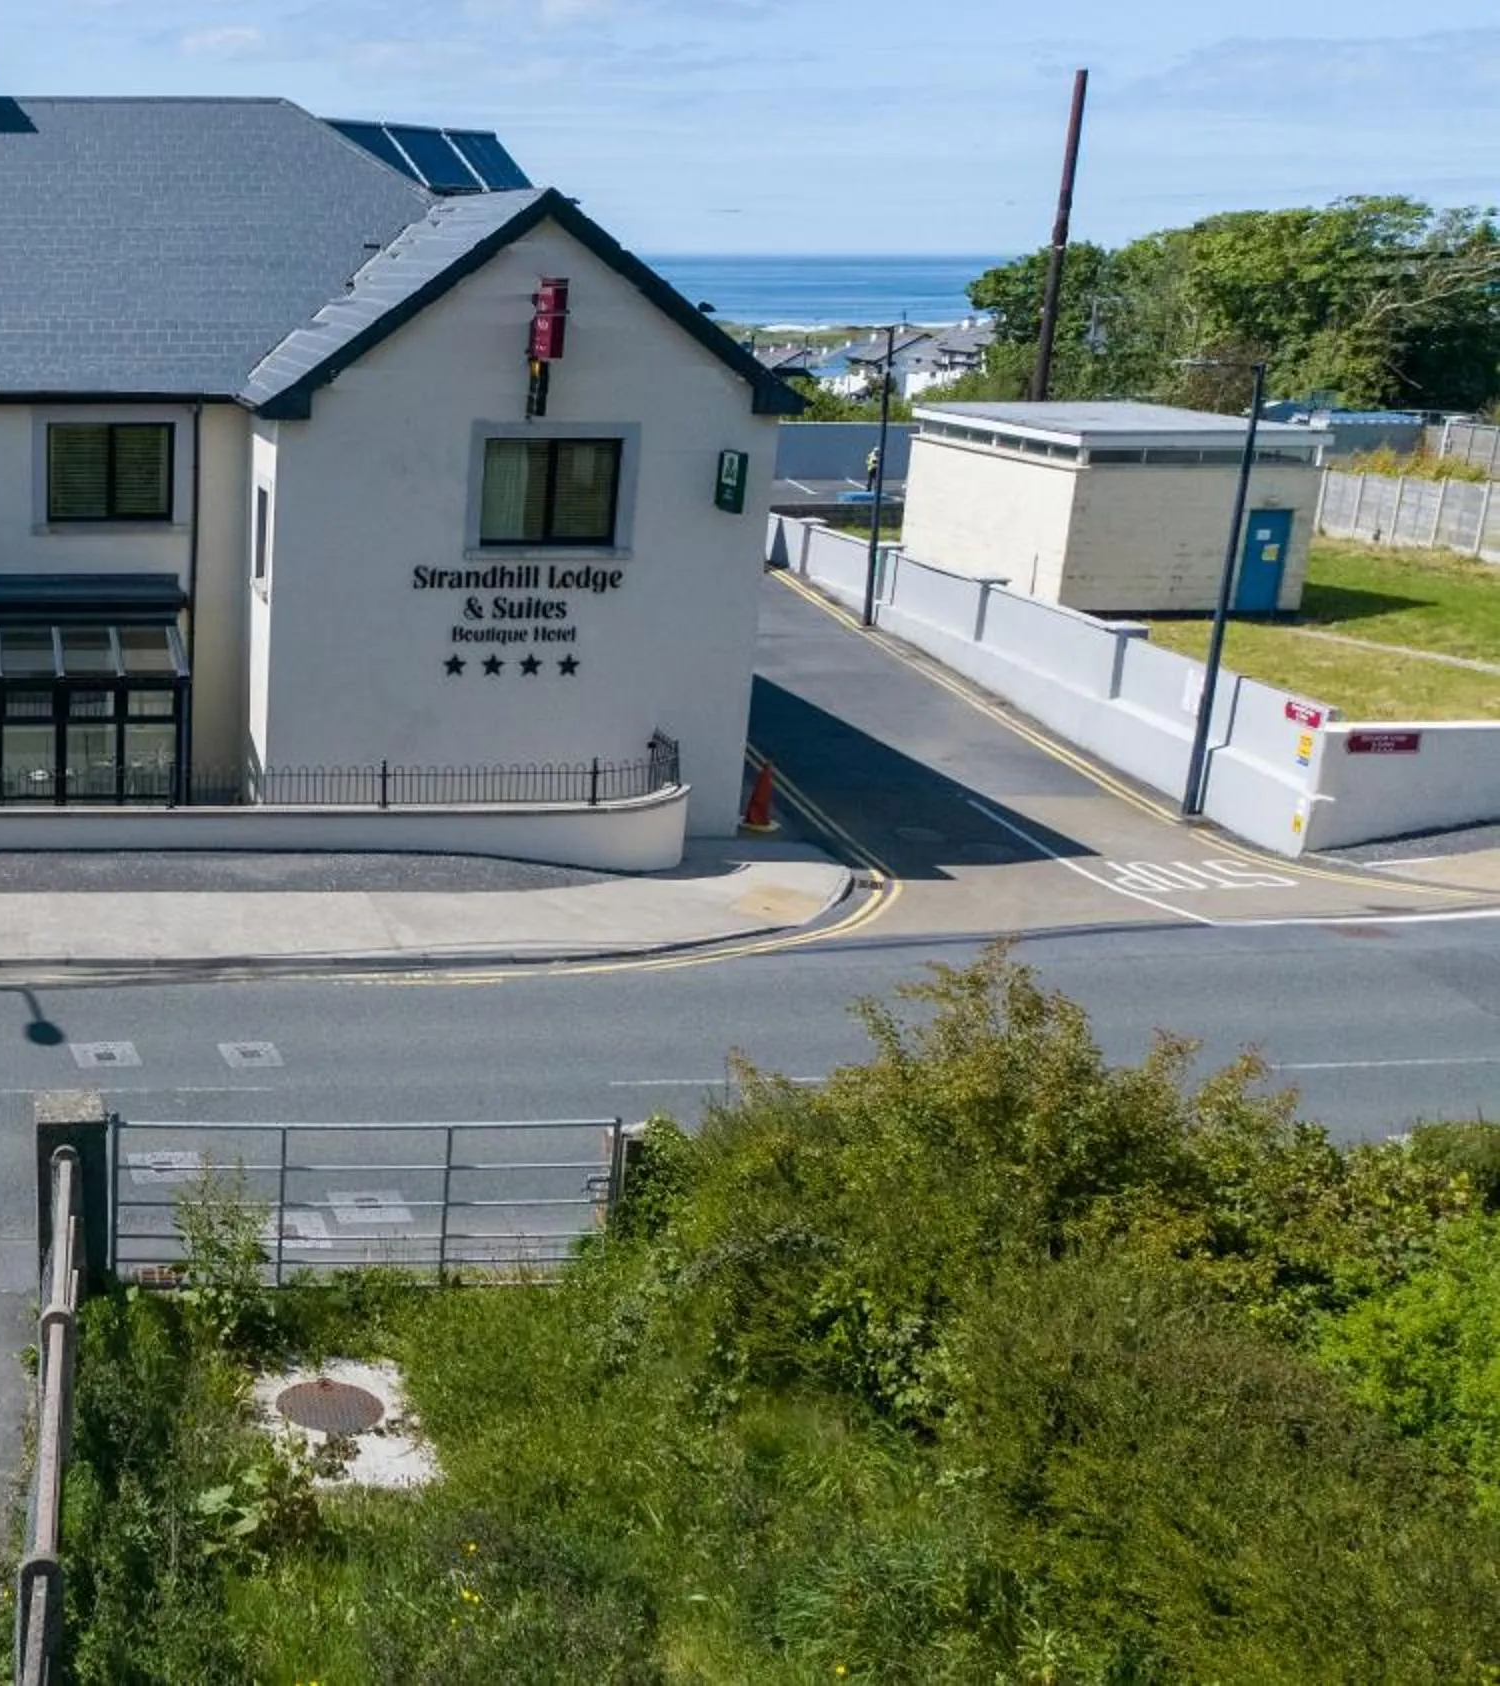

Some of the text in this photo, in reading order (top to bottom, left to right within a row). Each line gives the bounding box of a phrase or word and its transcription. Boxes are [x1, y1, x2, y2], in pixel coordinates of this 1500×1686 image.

[413, 565, 623, 593] Strandhill Lodge
[463, 596, 567, 620] & Suites
[452, 626, 576, 644] Boutique Hotel
[1107, 859, 1300, 892] STOP
